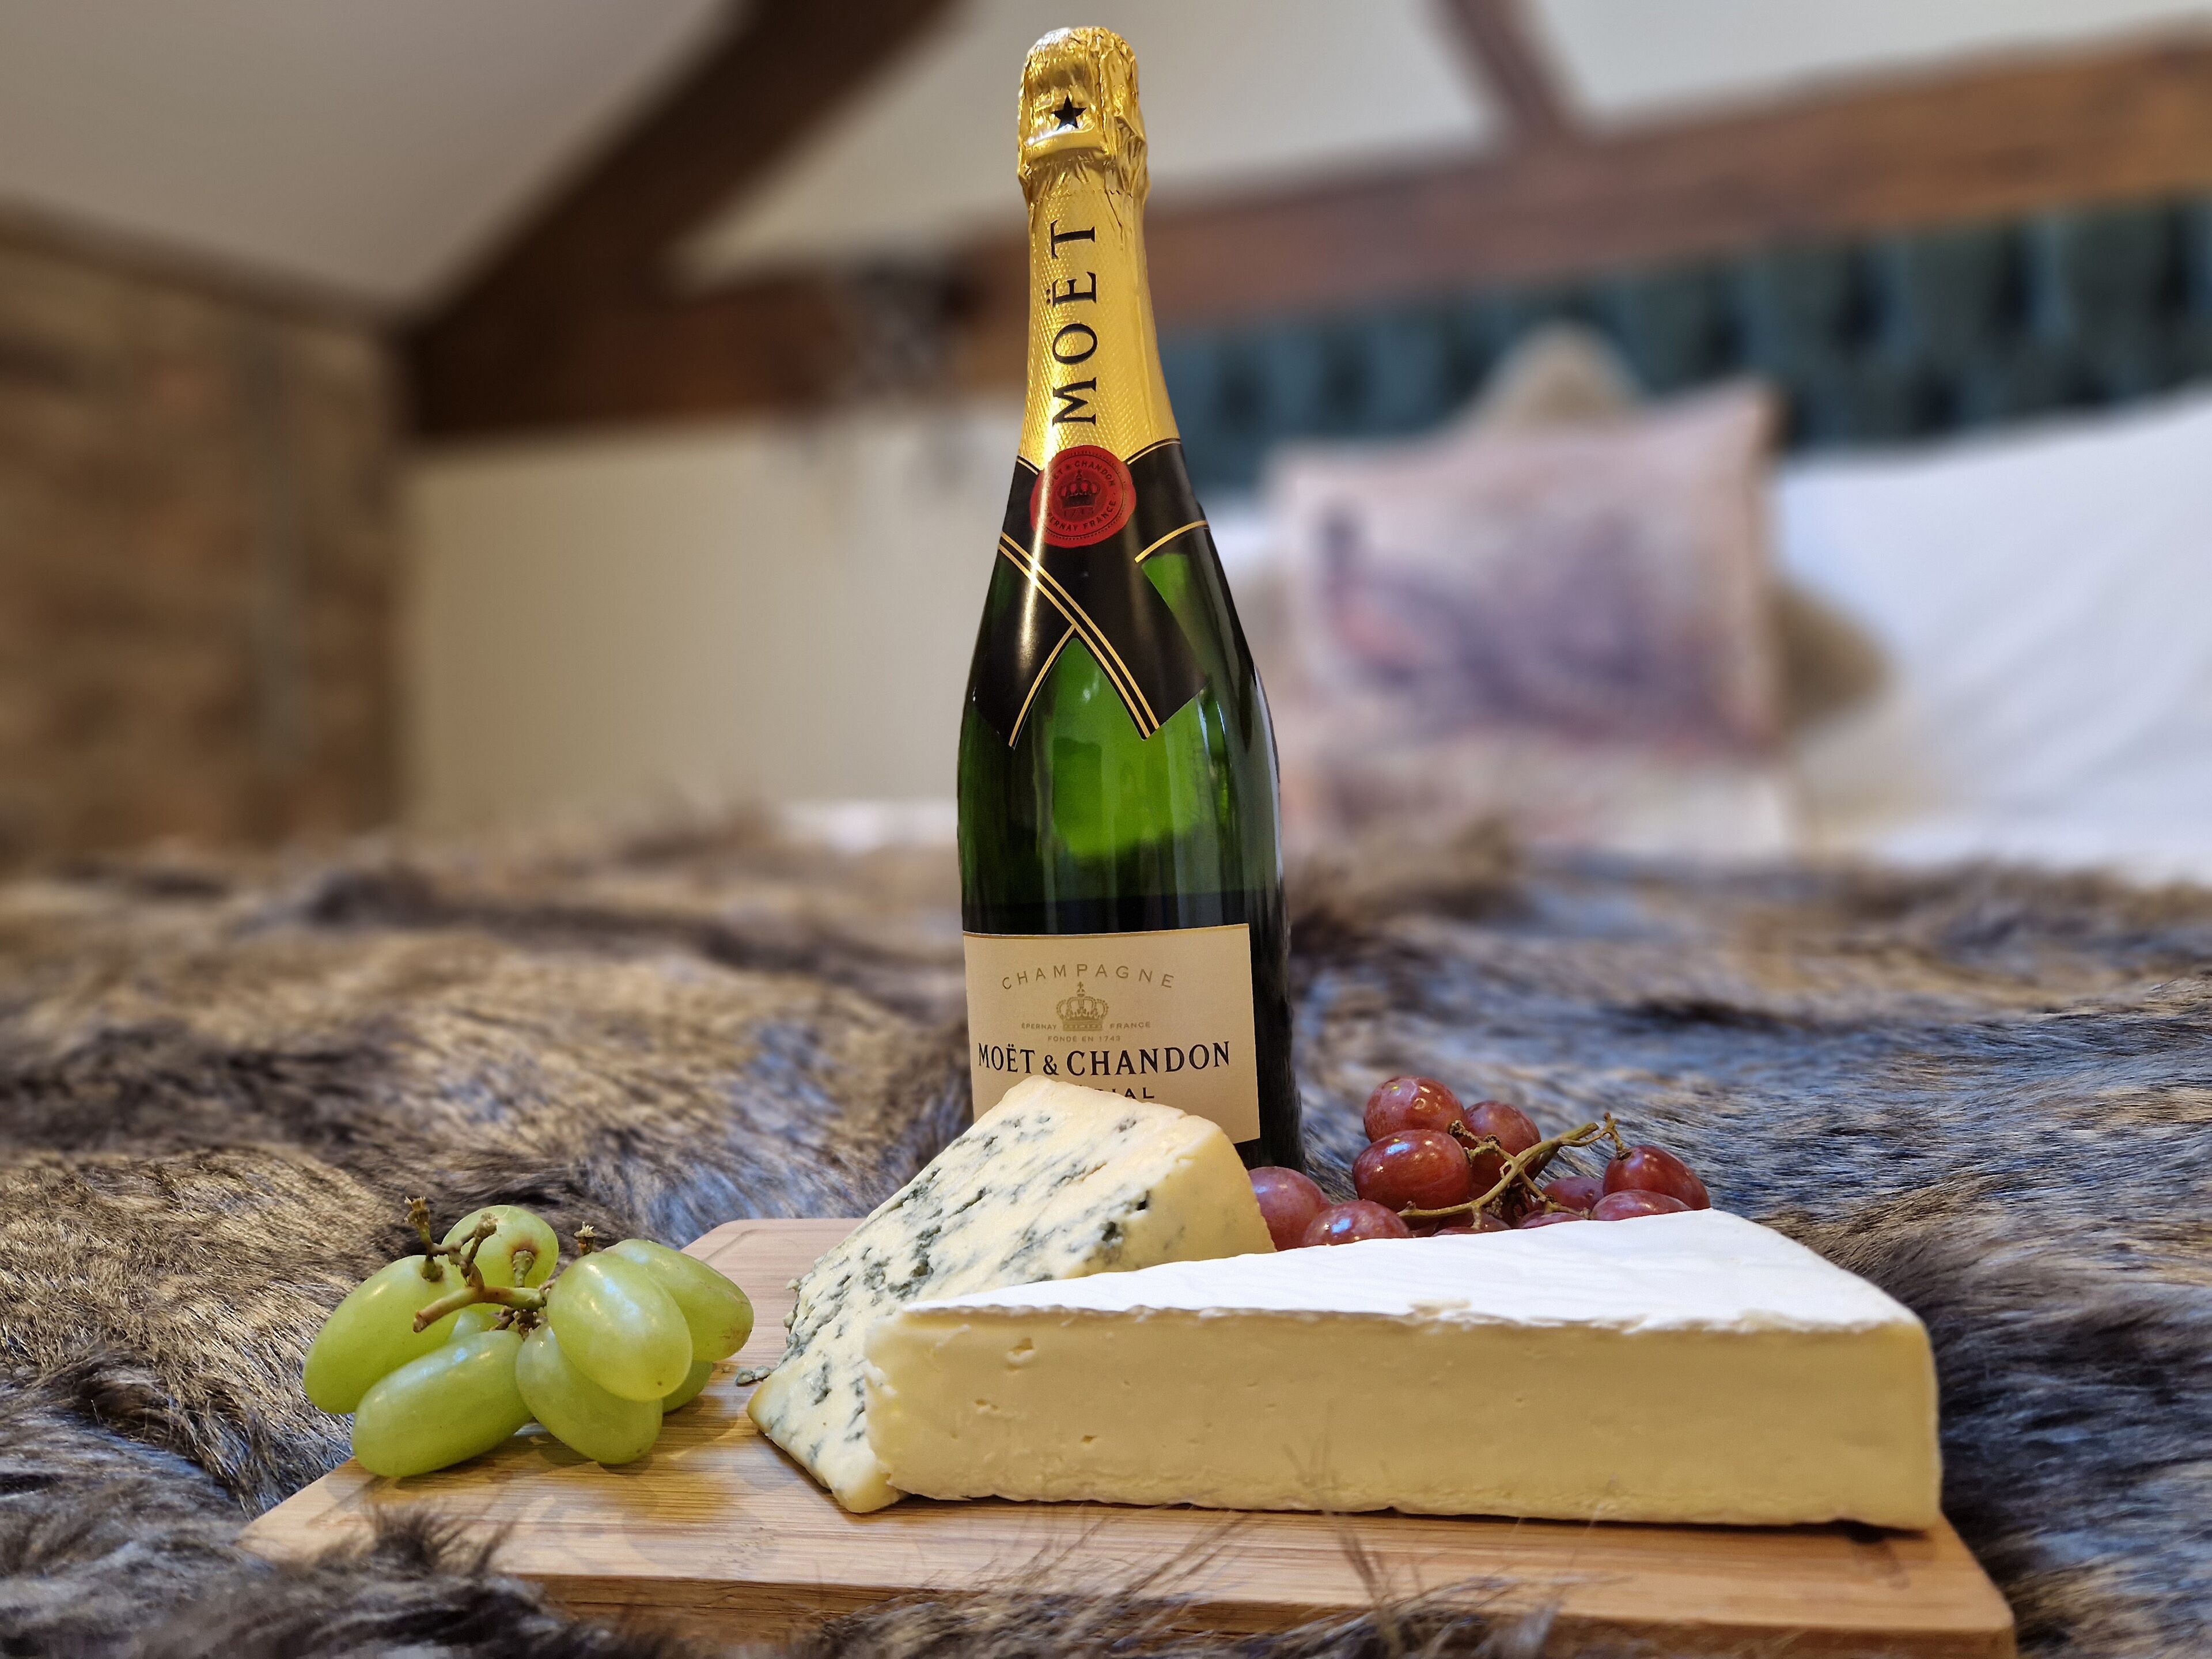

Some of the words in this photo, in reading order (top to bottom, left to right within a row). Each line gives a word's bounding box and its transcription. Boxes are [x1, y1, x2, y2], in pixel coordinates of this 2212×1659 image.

[1046, 219, 1098, 425] MOËT
[1082, 500, 1116, 529] FRANCE
[1002, 964, 1174, 990] CHAMPAGNE
[1109, 1021, 1151, 1029] FRANCE
[978, 1043, 1036, 1074] MOËT
[1043, 1054, 1060, 1075] &
[1066, 1041, 1230, 1076] CHANDON
